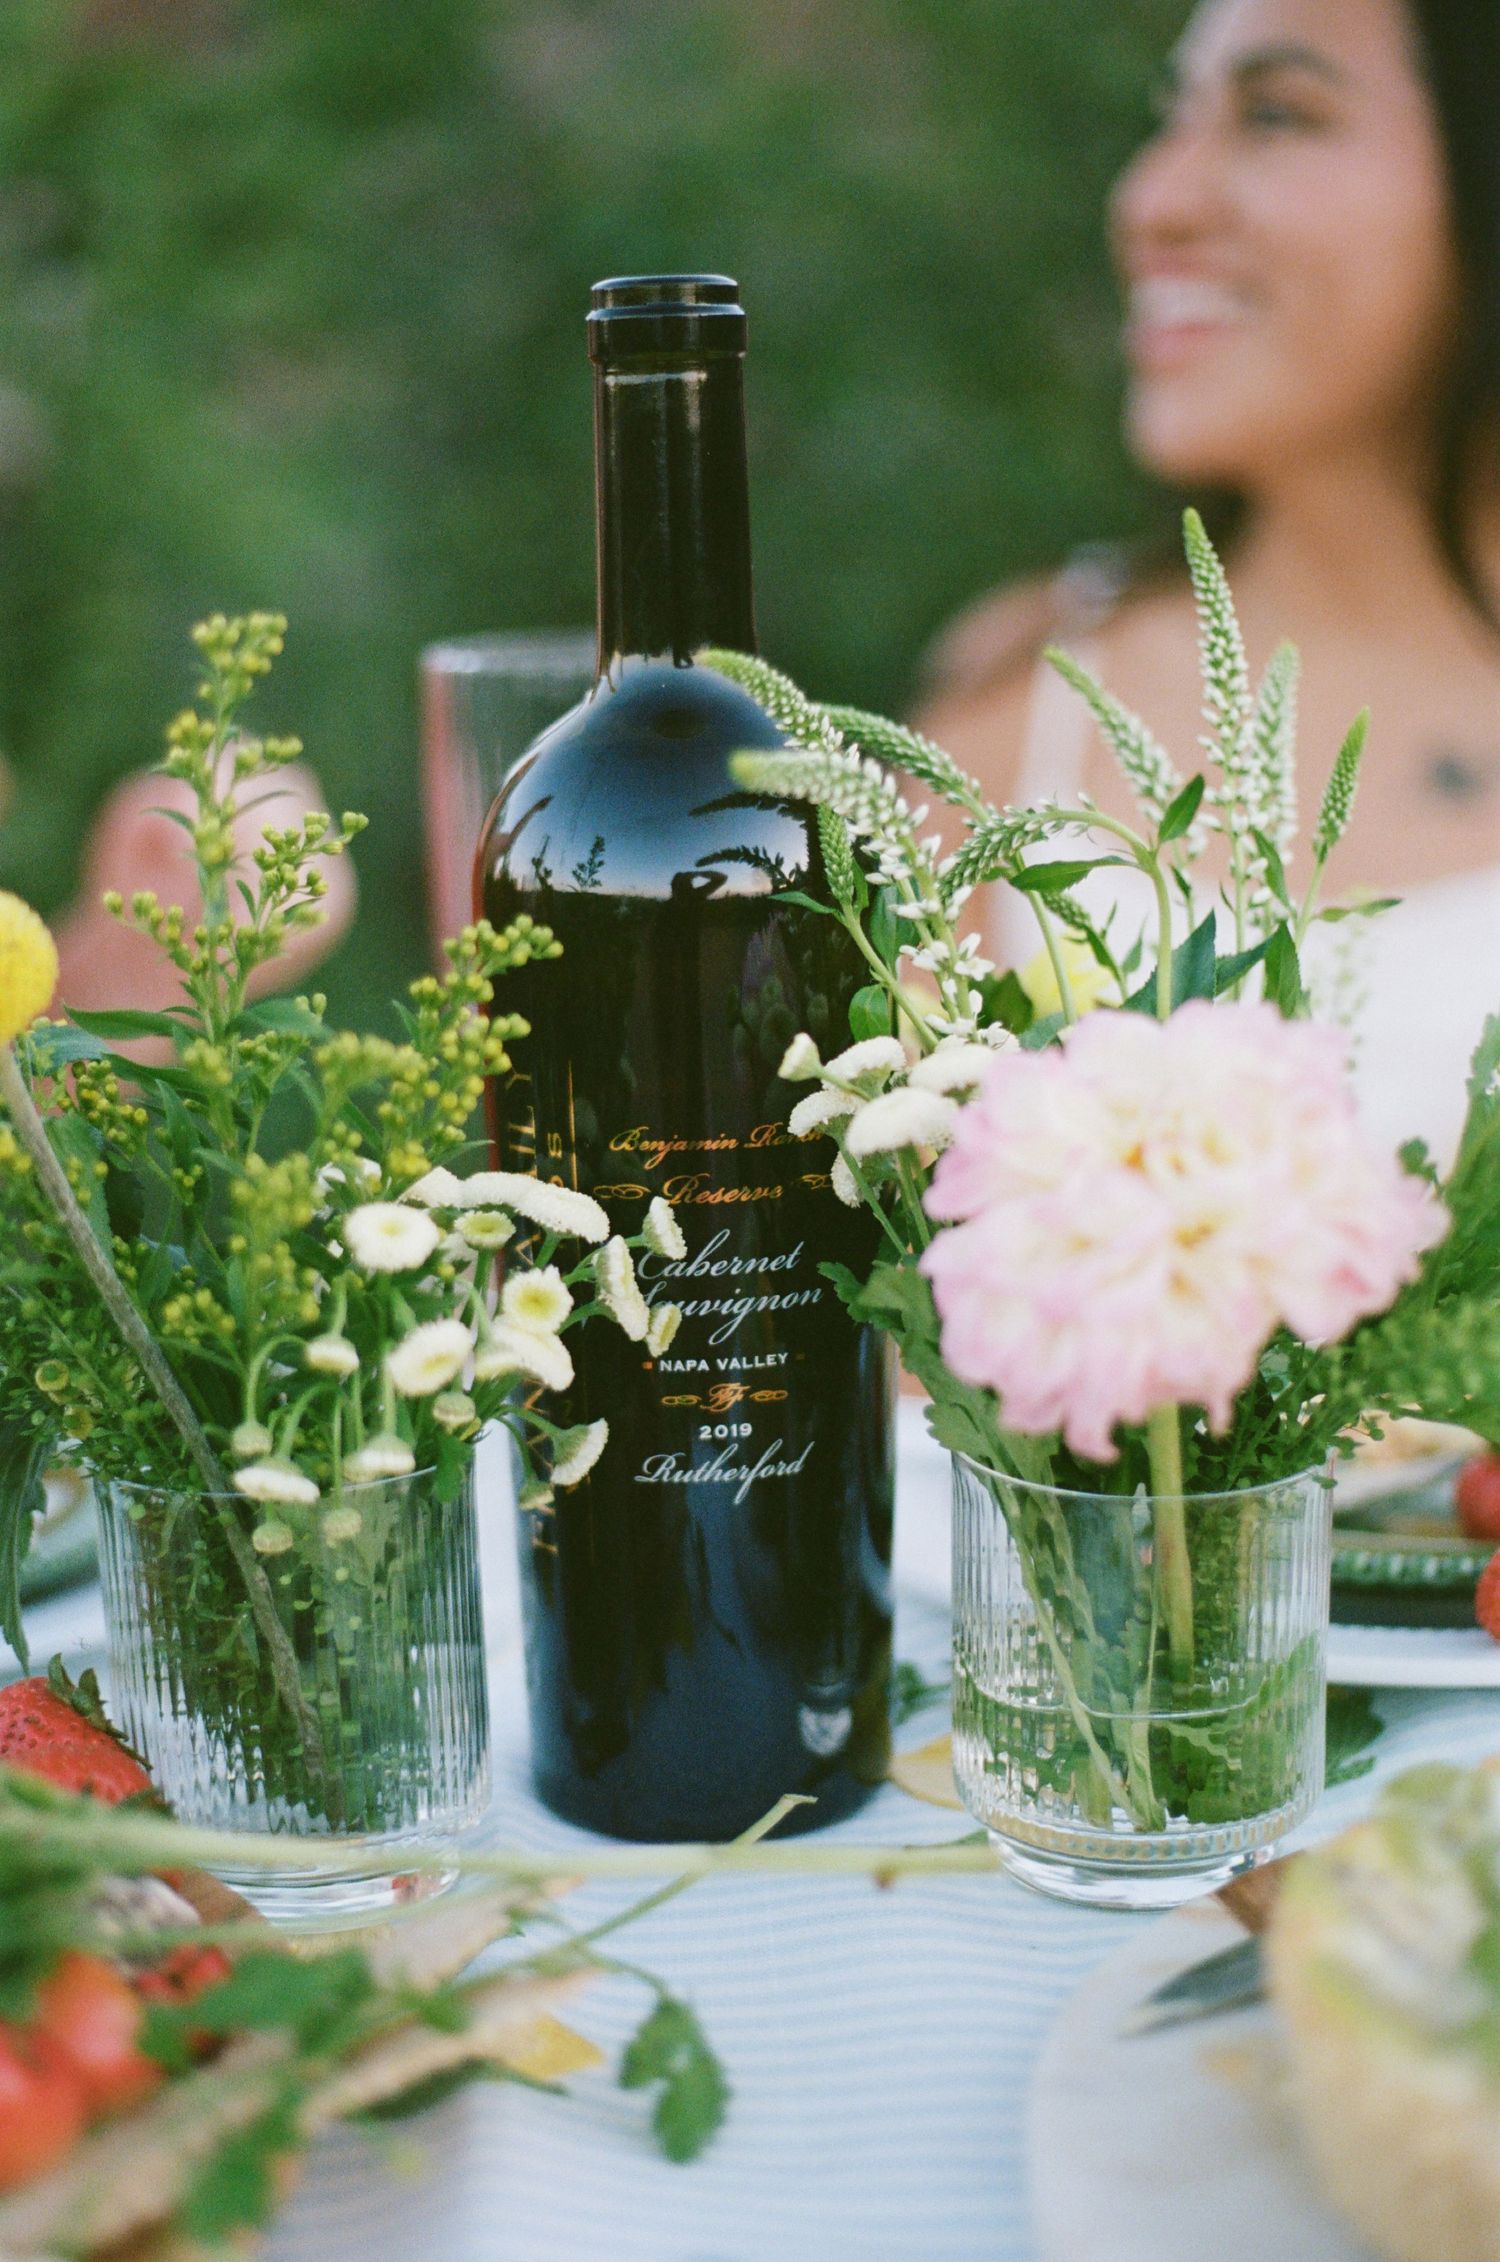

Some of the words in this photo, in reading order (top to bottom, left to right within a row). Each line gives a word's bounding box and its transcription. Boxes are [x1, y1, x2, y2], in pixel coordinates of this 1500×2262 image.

[609, 1126, 738, 1170] Benjamin
[662, 1172, 784, 1206] Reserve
[637, 1228, 805, 1280] Cabernet
[659, 1358, 710, 1372] NAPA
[715, 1352, 789, 1371] VALLEY
[699, 1422, 753, 1440] 2019
[633, 1438, 816, 1505] Rutherford
